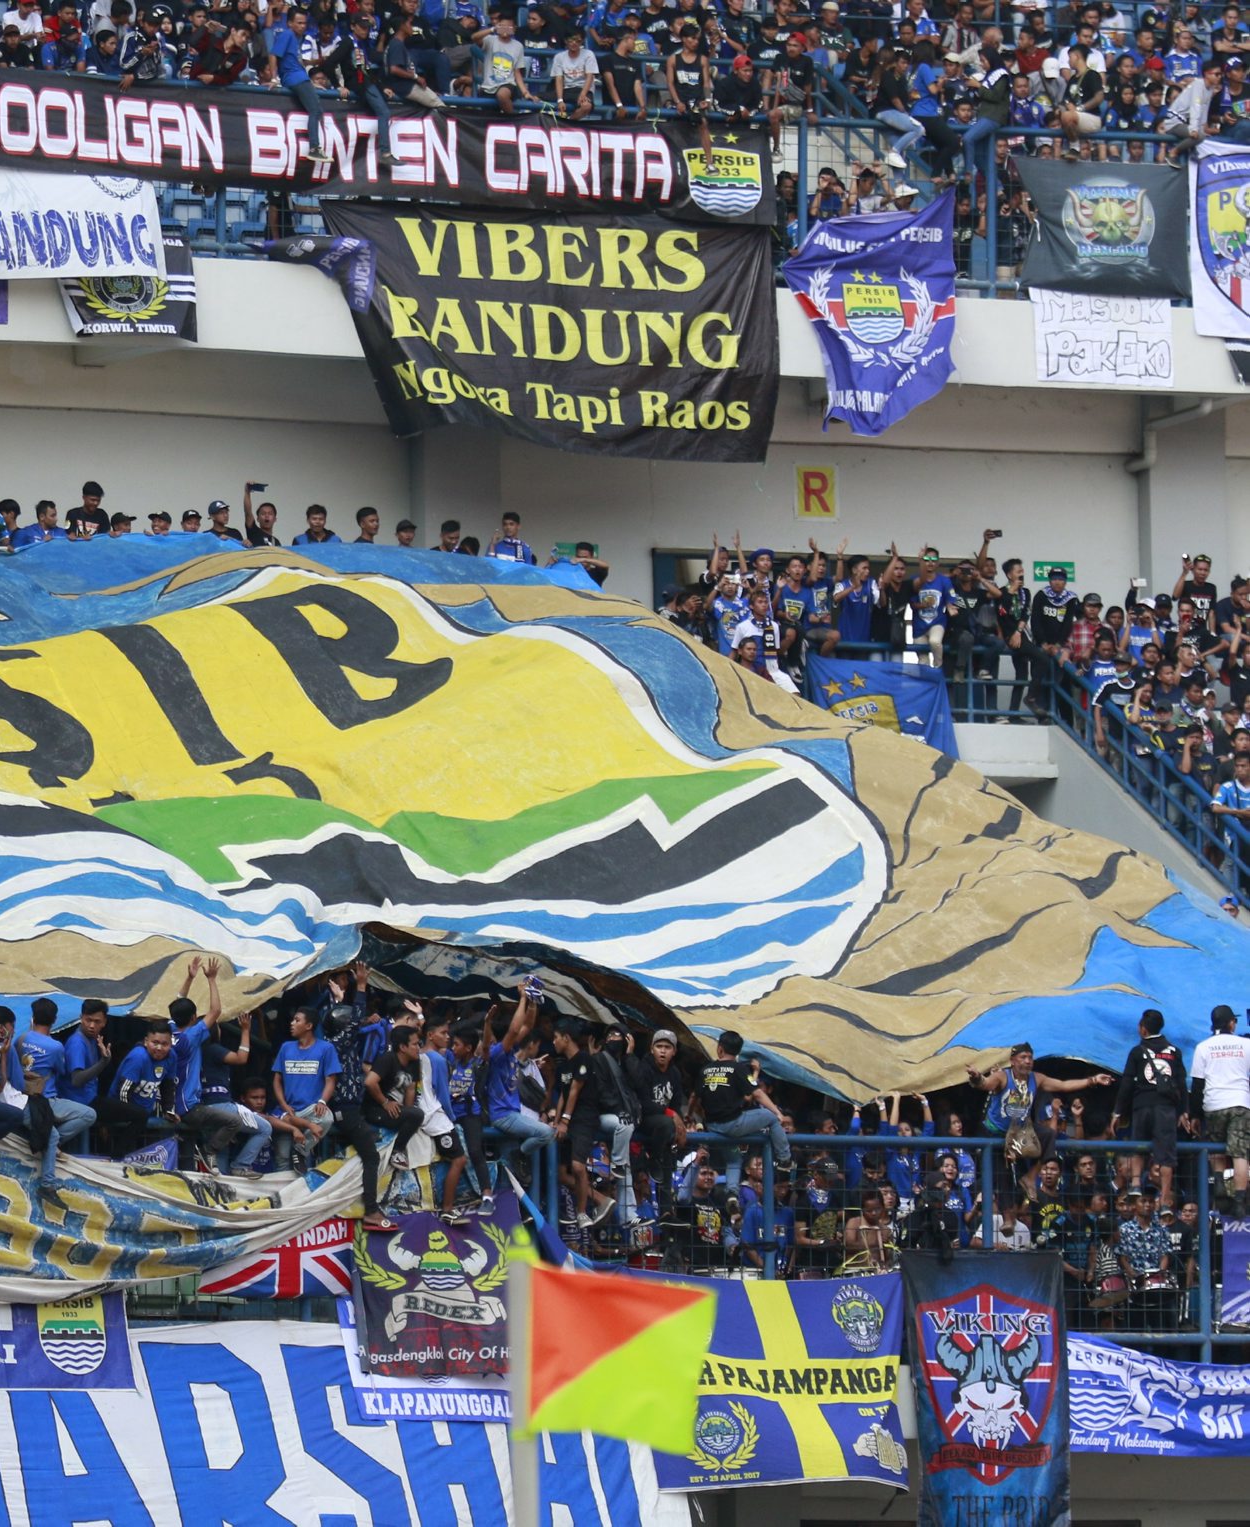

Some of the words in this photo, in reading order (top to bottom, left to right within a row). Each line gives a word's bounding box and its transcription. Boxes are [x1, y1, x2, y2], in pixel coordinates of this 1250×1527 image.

[485, 123, 674, 203] CARITA
[686, 151, 757, 167] PERSIB
[901, 226, 944, 244] PERSIB
[394, 216, 707, 293] VIBERS
[846, 286, 896, 297] PERSIB
[83, 322, 134, 334] KORWIL
[135, 323, 177, 334] TIMUR
[382, 285, 743, 371] BANDUNG
[525, 381, 625, 434] Tapi
[640, 390, 752, 432] Raos
[803, 471, 832, 513] R
[297, 1219, 348, 1247] INDAH
[44, 1297, 95, 1310] PERSIB
[404, 1294, 486, 1321] REDEX
[835, 1289, 870, 1302] VIKING
[926, 1309, 1051, 1336] VIKING
[448, 1347, 475, 1363] City
[479, 1345, 498, 1360] Of
[858, 1407, 875, 1417] ON
[1069, 1430, 1110, 1453] Tandang
[1108, 1430, 1176, 1455] Makalangan
[720, 1473, 742, 1481] APRIL
[743, 1471, 761, 1479] 2017
[953, 1494, 993, 1527] THE
